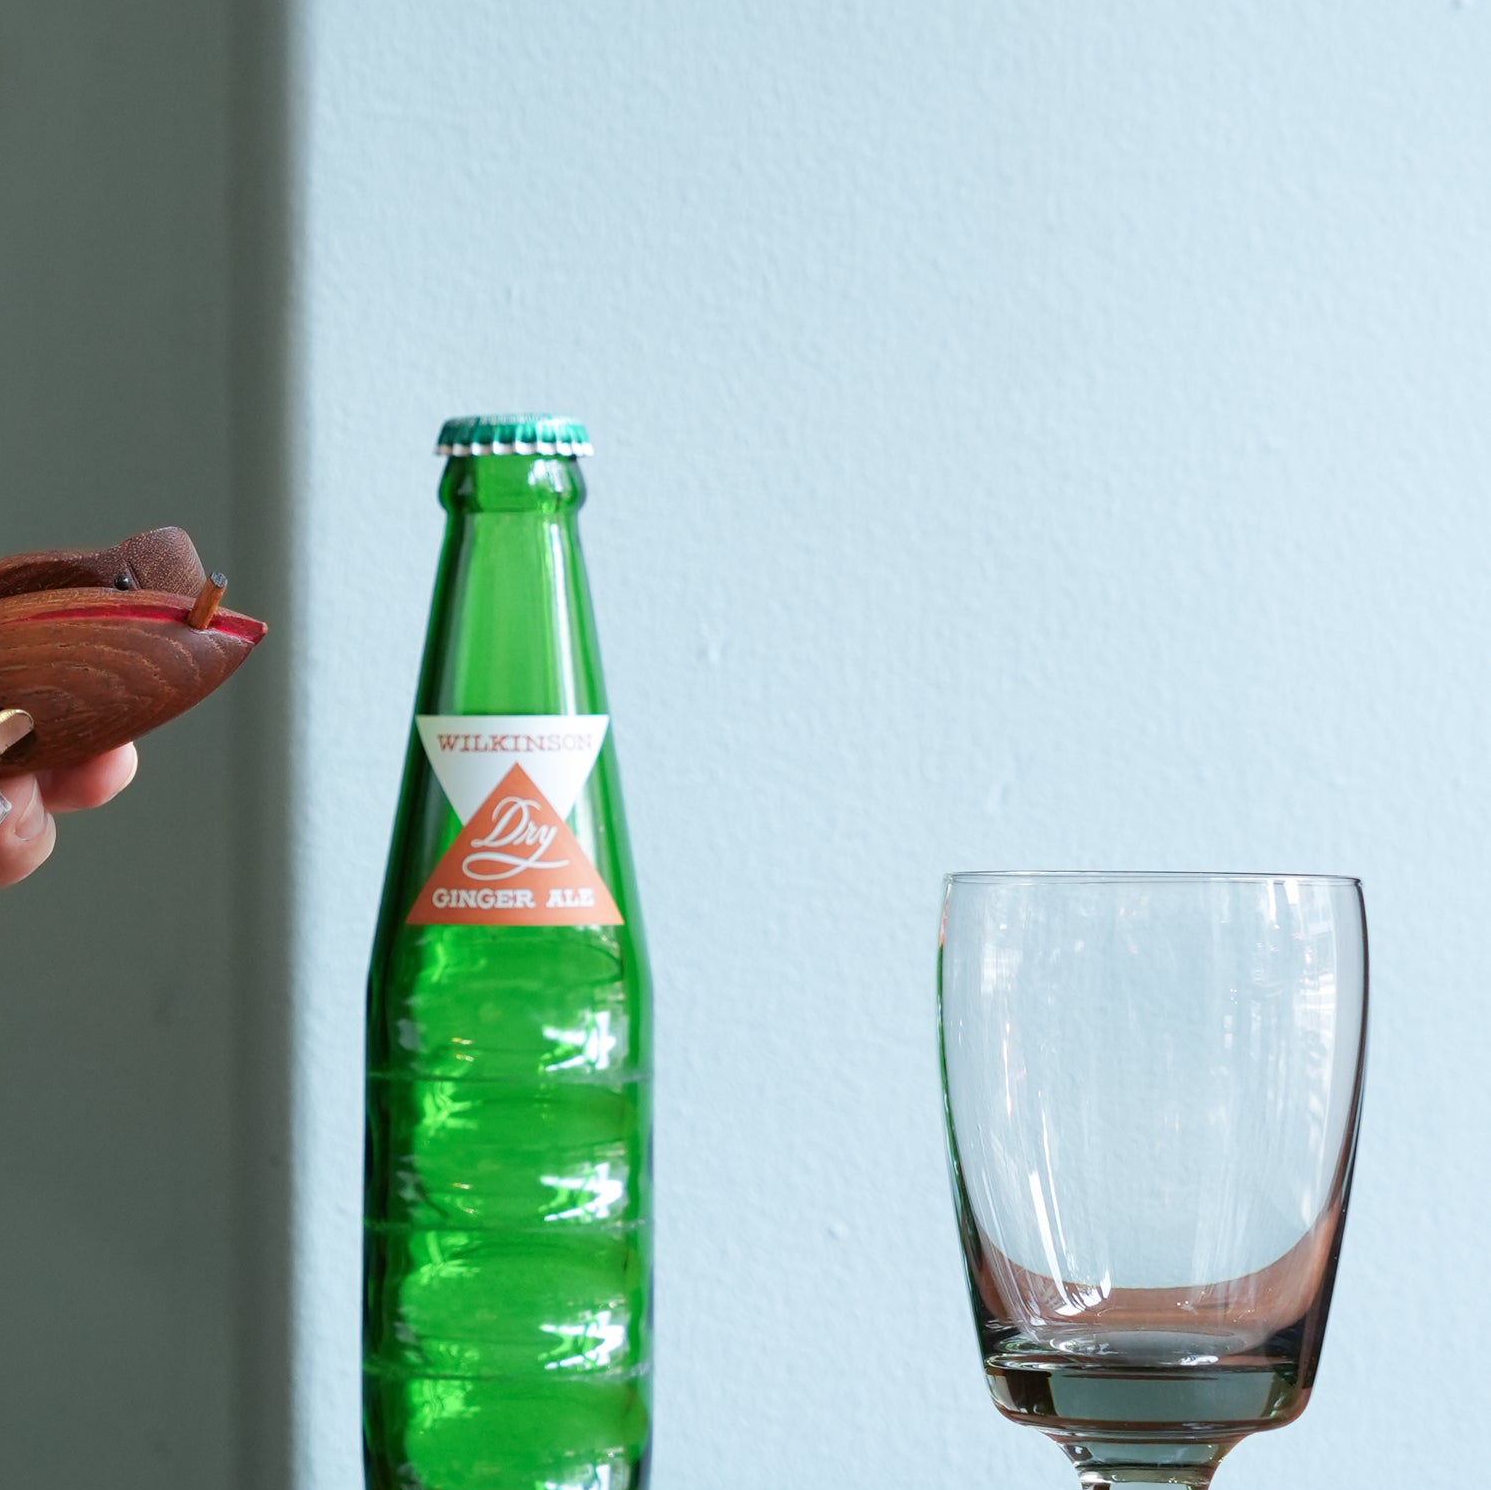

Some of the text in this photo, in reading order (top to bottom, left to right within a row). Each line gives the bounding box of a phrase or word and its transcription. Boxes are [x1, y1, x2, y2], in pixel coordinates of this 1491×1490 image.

[437, 733, 592, 752] WILKINSON
[462, 796, 570, 881] Dry
[432, 887, 594, 909] GINGER ALE
